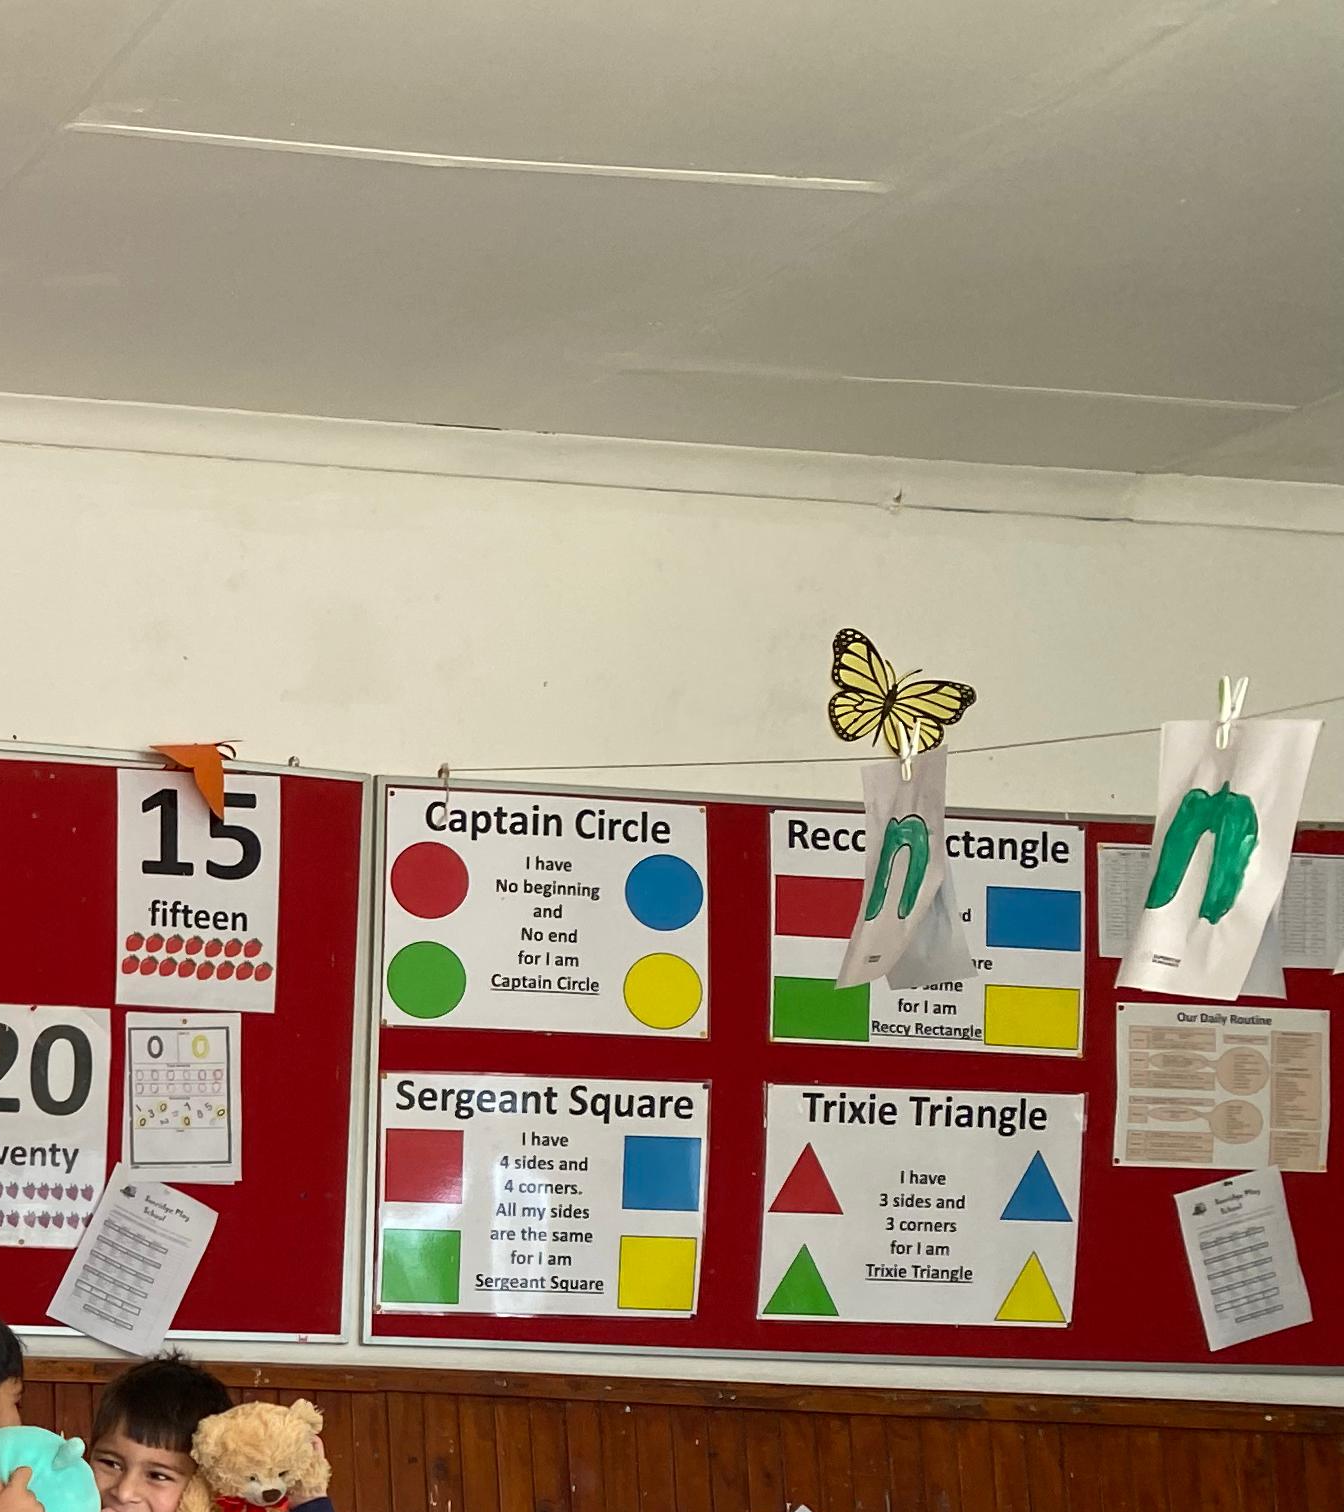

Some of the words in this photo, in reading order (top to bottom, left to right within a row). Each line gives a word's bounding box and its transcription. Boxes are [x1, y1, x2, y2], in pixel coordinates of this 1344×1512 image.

[426, 802, 562, 840] Captain
[576, 809, 670, 844] Circle
[141, 788, 262, 880] 15
[787, 819, 866, 853] Recc
[945, 833, 1070, 868] ctangle
[536, 856, 572, 872] have
[496, 879, 518, 892] No
[524, 879, 600, 901] beginning
[149, 900, 247, 931] fifteen
[534, 904, 562, 918] and
[522, 928, 543, 941] No
[549, 929, 577, 943] end
[518, 950, 541, 965] for
[555, 956, 578, 967] am
[491, 973, 553, 991] Captain
[557, 977, 600, 992] Circle
[898, 999, 919, 1013] for
[933, 1003, 957, 1015] am
[1177, 1012, 1197, 1023] Our
[1200, 1013, 1227, 1025] Daily
[1230, 1014, 1272, 1026] Routine
[871, 1020, 911, 1036] Reccy
[915, 1023, 982, 1039] Rectangle
[147, 1035, 163, 1059] 0
[396, 1080, 558, 1120] Sergeant
[569, 1085, 693, 1124] Square
[803, 1093, 897, 1125] Trixie
[909, 1096, 1047, 1136] Triangle
[532, 1132, 568, 1147] have
[500, 1156, 509, 1168] 4
[515, 1155, 554, 1170] sides
[559, 1157, 588, 1171] and
[910, 1170, 946, 1185] have
[505, 1180, 513, 1192] 4
[519, 1183, 583, 1195] corners.
[880, 1194, 887, 1206] 3
[893, 1194, 931, 1208] sides
[936, 1195, 965, 1209] and
[496, 1202, 516, 1216] All
[522, 1207, 546, 1221] my
[551, 1204, 589, 1219] sides
[886, 1217, 894, 1230] 3
[900, 1221, 957, 1232] corners
[490, 1230, 515, 1240] are
[521, 1227, 547, 1241] the
[552, 1232, 592, 1242] same
[890, 1240, 913, 1254] for
[926, 1245, 949, 1256] am
[511, 1250, 534, 1264] for
[548, 1255, 571, 1266] am
[866, 1264, 905, 1279] Trixie
[908, 1265, 972, 1281] Triangle
[476, 1274, 545, 1292] Sergeant
[550, 1276, 604, 1293] Square
